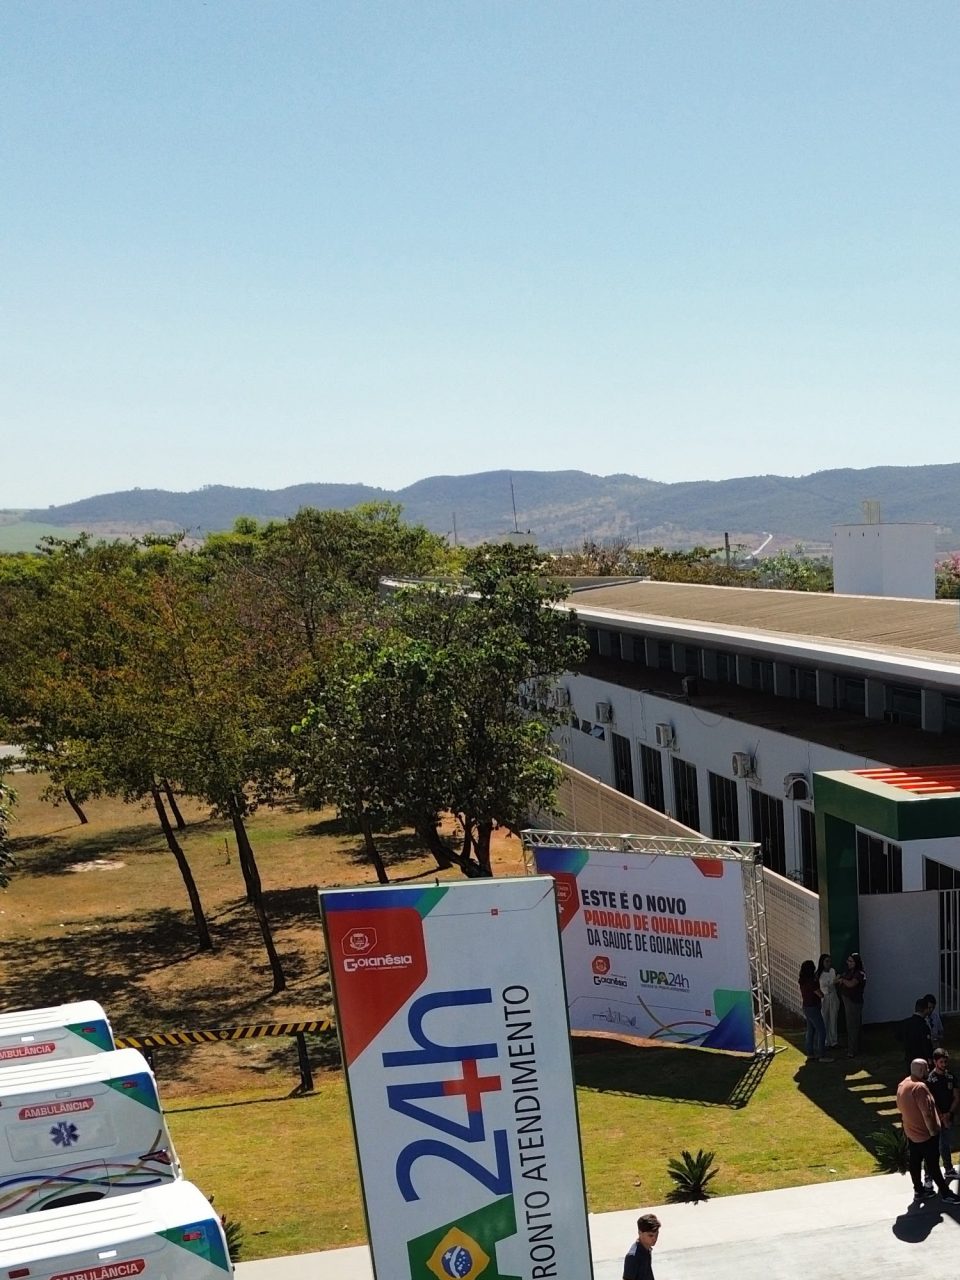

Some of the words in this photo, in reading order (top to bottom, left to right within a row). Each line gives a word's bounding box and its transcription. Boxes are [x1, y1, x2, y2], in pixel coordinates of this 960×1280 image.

[581, 889, 617, 909] ESTE
[620, 890, 629, 910] É
[633, 893, 643, 911] O
[646, 894, 687, 915] NOVO
[633, 914, 649, 932] DE
[650, 915, 718, 939] QUALIDADE
[587, 928, 601, 947] DA
[635, 933, 648, 953] DE
[649, 935, 703, 959] GOIANÉSIA
[639, 969, 669, 986] UPA
[668, 972, 690, 988] 24h
[0, 1045, 51, 1059] MBULÂNCIA
[382, 988, 514, 1202] 24h
[502, 985, 548, 1182] ATENDIMENTO
[24, 1101, 89, 1118] AMBULÂNCIA
